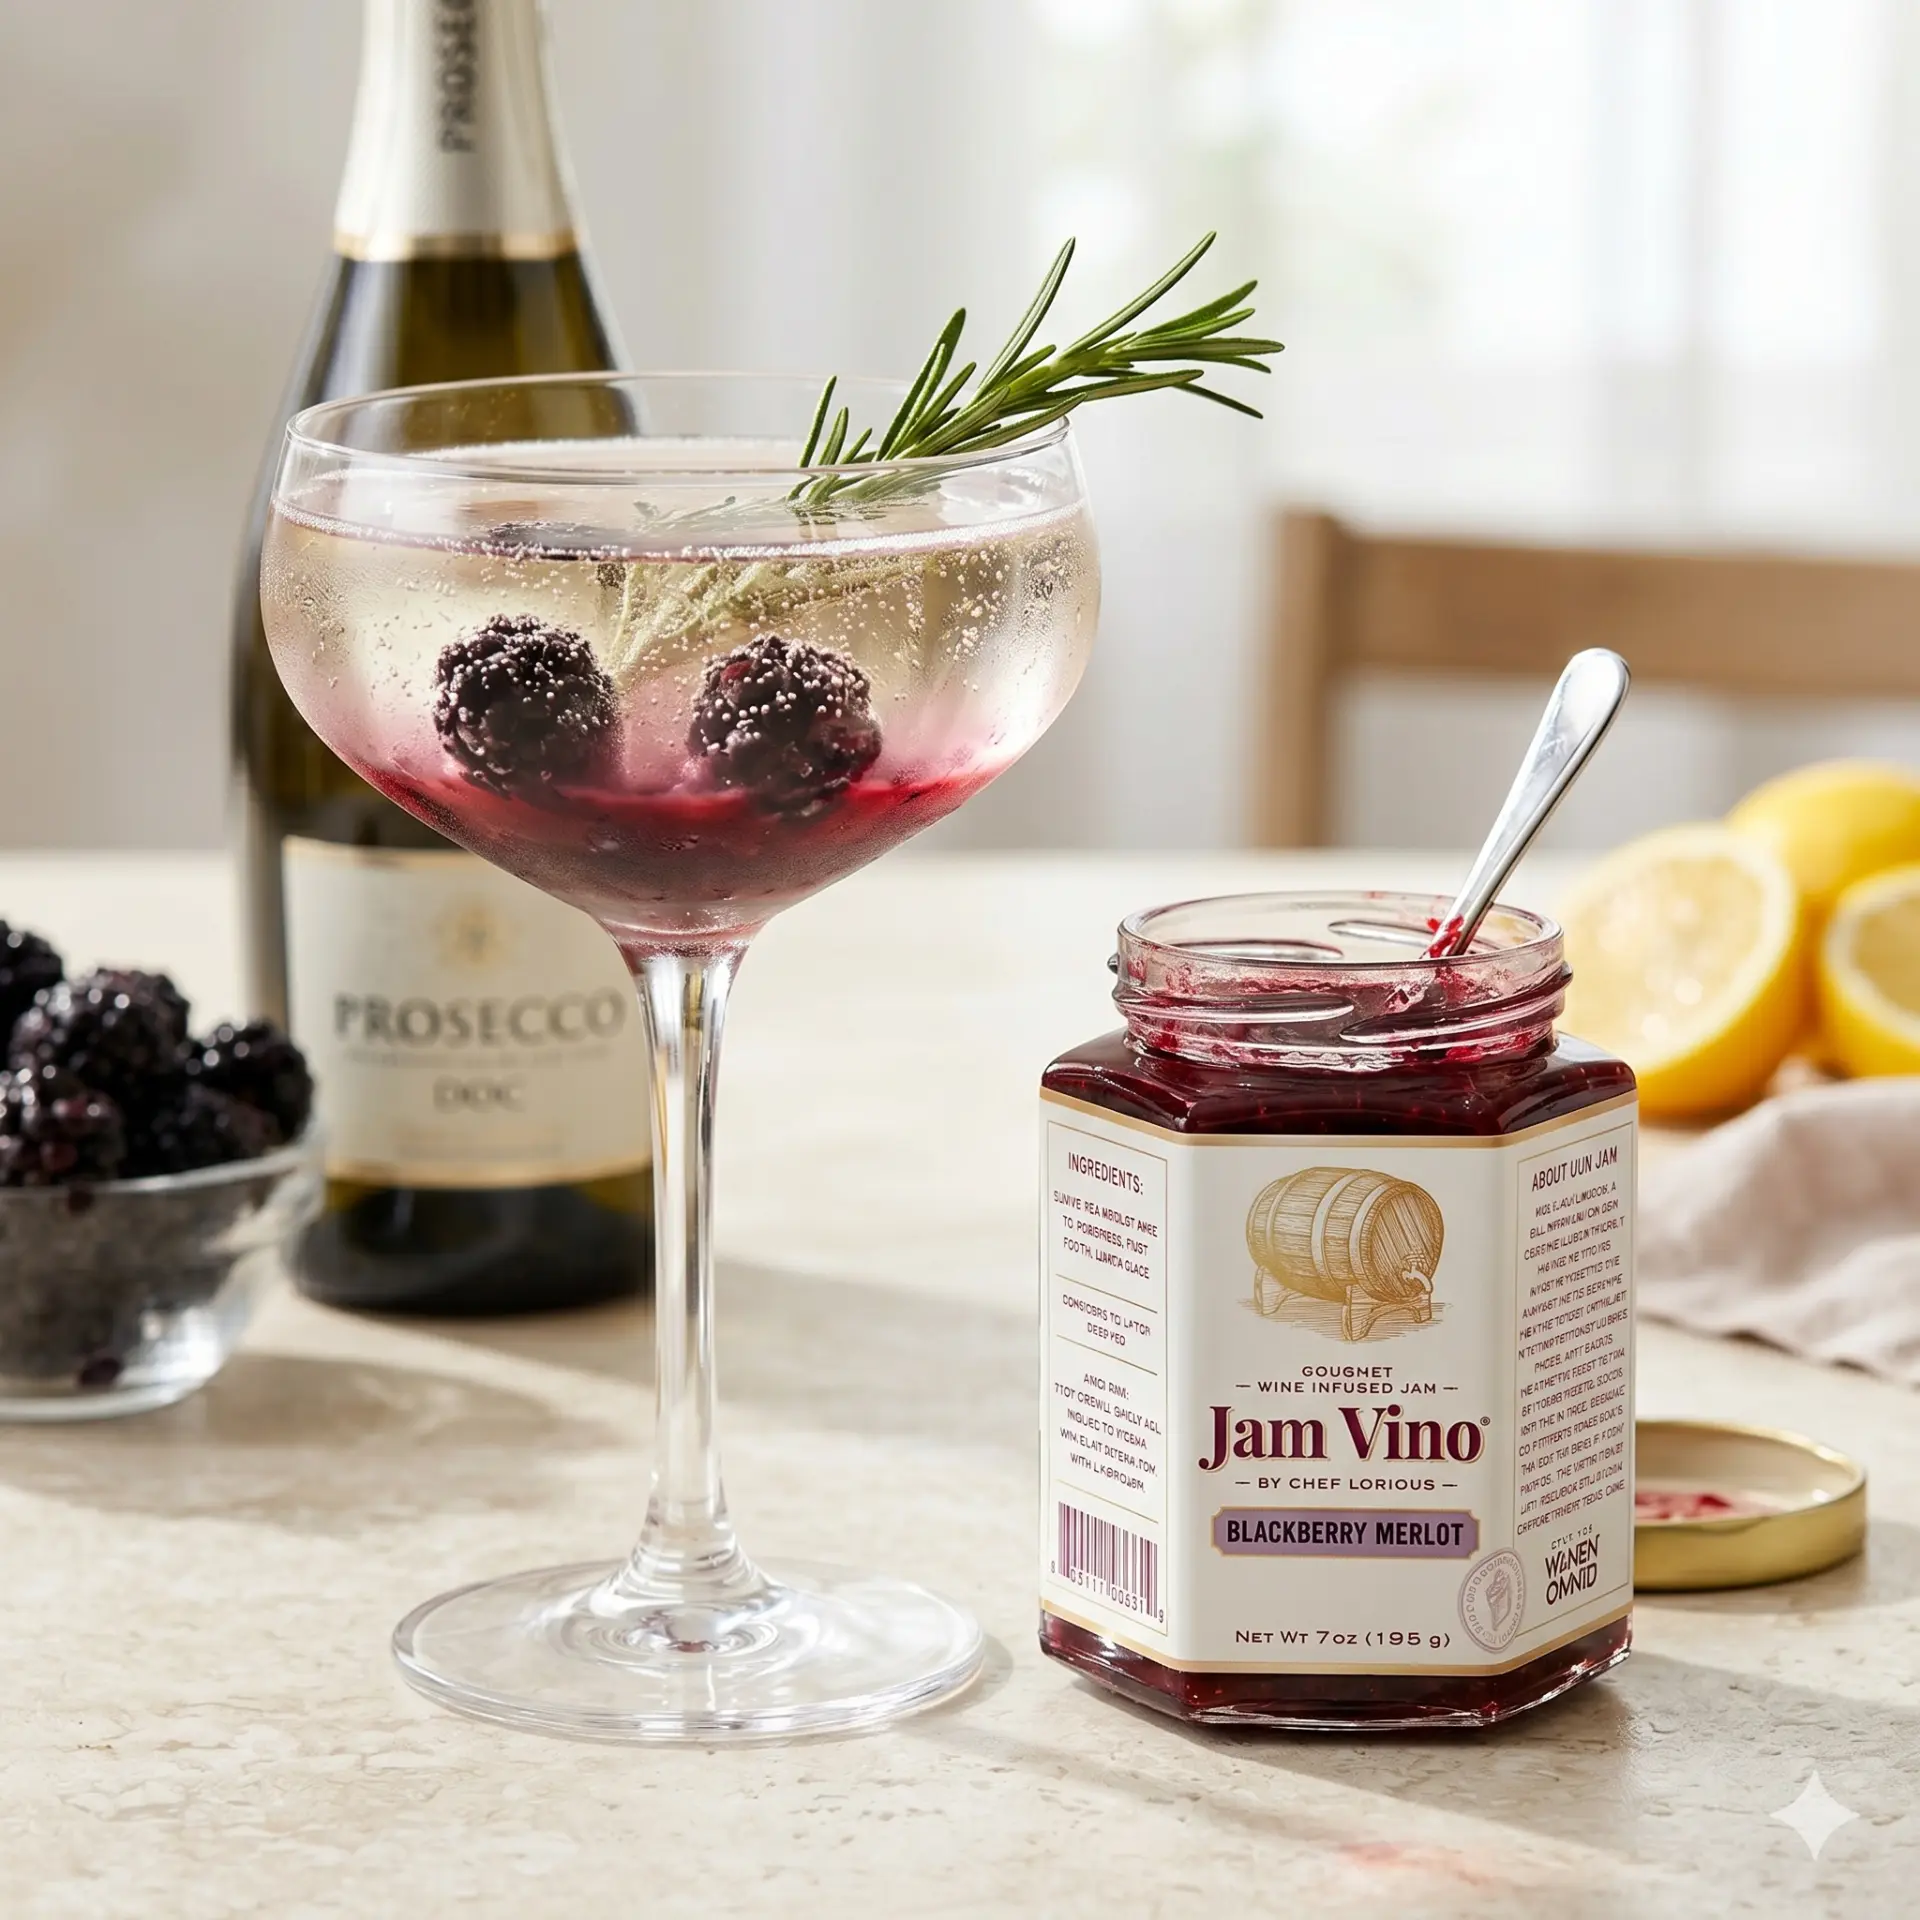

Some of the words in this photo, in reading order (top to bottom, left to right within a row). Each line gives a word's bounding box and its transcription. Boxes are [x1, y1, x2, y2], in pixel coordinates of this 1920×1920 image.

[334, 986, 627, 1048] PROSECCO
[1068, 1152, 1144, 1195] INGREDIENTS:
[1532, 1163, 1567, 1191] ABOUT
[1595, 1146, 1618, 1169] JAM
[1258, 1381, 1304, 1393] WINE
[1312, 1382, 1393, 1394] INFUSED
[1400, 1383, 1437, 1394] JAM
[1102, 1422, 1114, 1436] TO
[1198, 1404, 1330, 1471] Jam
[1258, 1478, 1281, 1489] BY
[1289, 1478, 1341, 1490] CHEF
[1350, 1478, 1436, 1491] LORIOUS
[1227, 1520, 1367, 1544] BLACKBERRY
[1376, 1522, 1464, 1546] MERLOT
[1365, 1632, 1421, 1647] (195
[1429, 1633, 1451, 1649] g)
